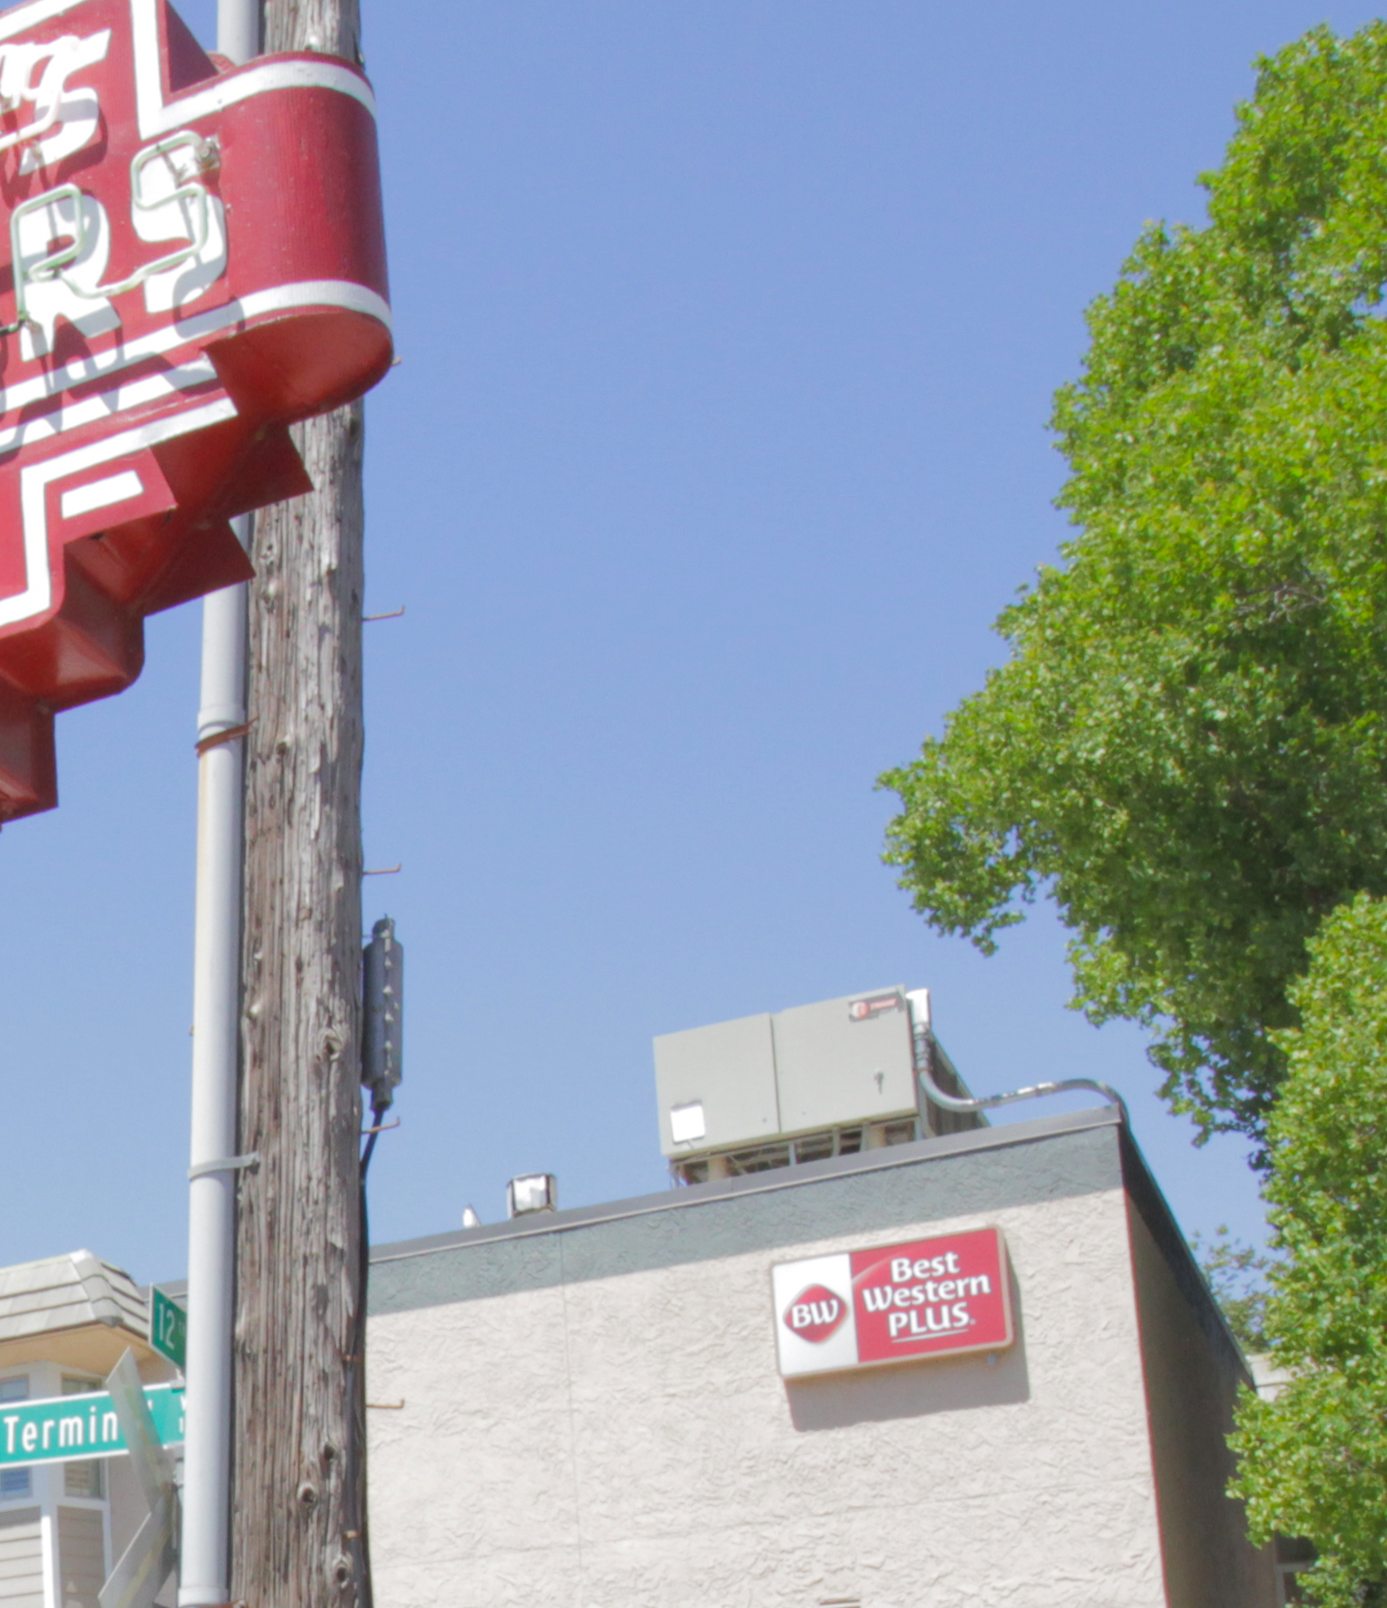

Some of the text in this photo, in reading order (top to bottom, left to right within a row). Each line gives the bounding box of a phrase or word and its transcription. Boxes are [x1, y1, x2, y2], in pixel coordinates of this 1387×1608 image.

[890, 1251, 960, 1283] Best
[861, 1274, 992, 1313] Western
[791, 1298, 840, 1329] BW
[888, 1302, 970, 1337] PLUS
[3, 1400, 153, 1453] Termin
